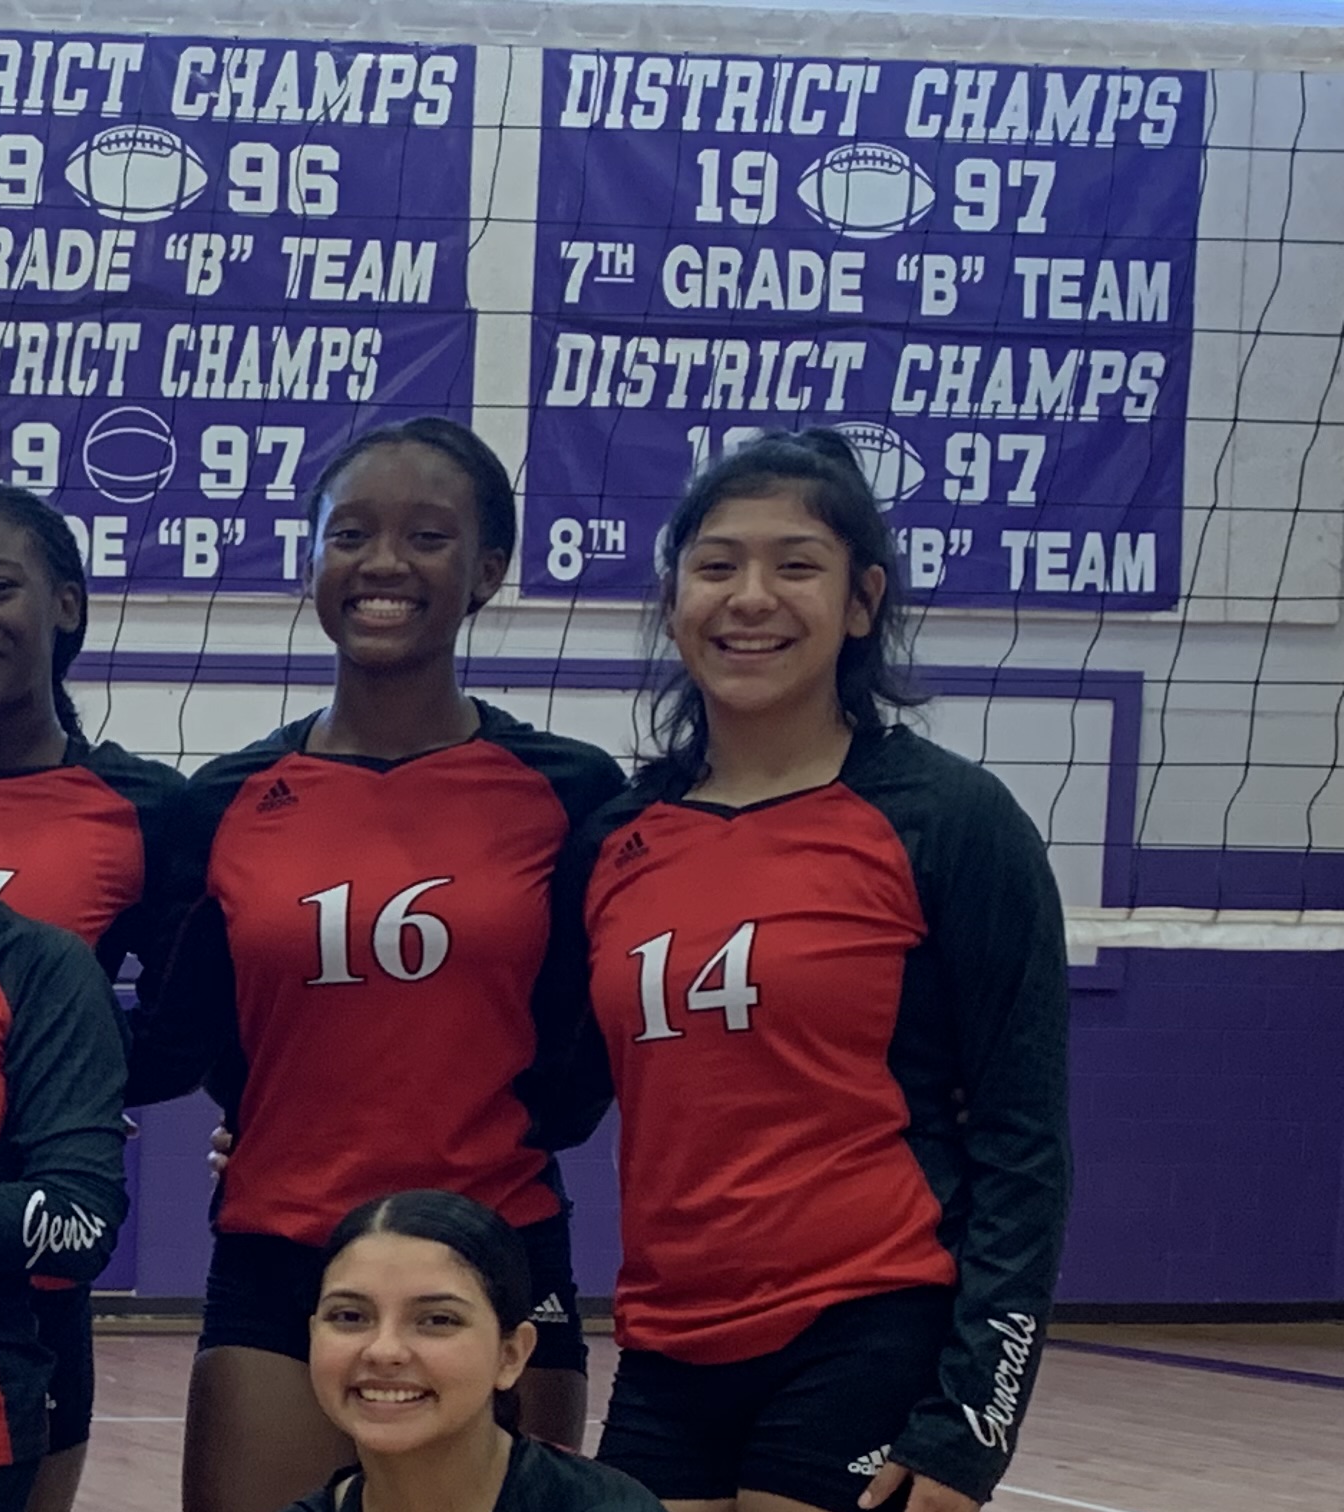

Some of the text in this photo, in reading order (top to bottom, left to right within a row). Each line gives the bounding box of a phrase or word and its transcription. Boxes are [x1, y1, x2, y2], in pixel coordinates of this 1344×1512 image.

[171, 46, 458, 128] CHAMPS
[561, 54, 1182, 150] DISTRICT CHAMPS
[228, 141, 340, 219] 96
[695, 148, 1057, 234] 19 97
[280, 236, 438, 304] TEAM
[662, 244, 865, 315] GRADE
[1014, 256, 1172, 323] TEAM
[160, 324, 382, 402] CHAMPS
[545, 332, 1166, 424] DISTRICT CHAMPS
[199, 425, 306, 501] 97
[942, 432, 1048, 507] 97
[1000, 529, 1158, 594] TEAM
[298, 875, 456, 986] 16
[627, 919, 761, 1044] 14
[962, 1311, 1038, 1454] Generals
